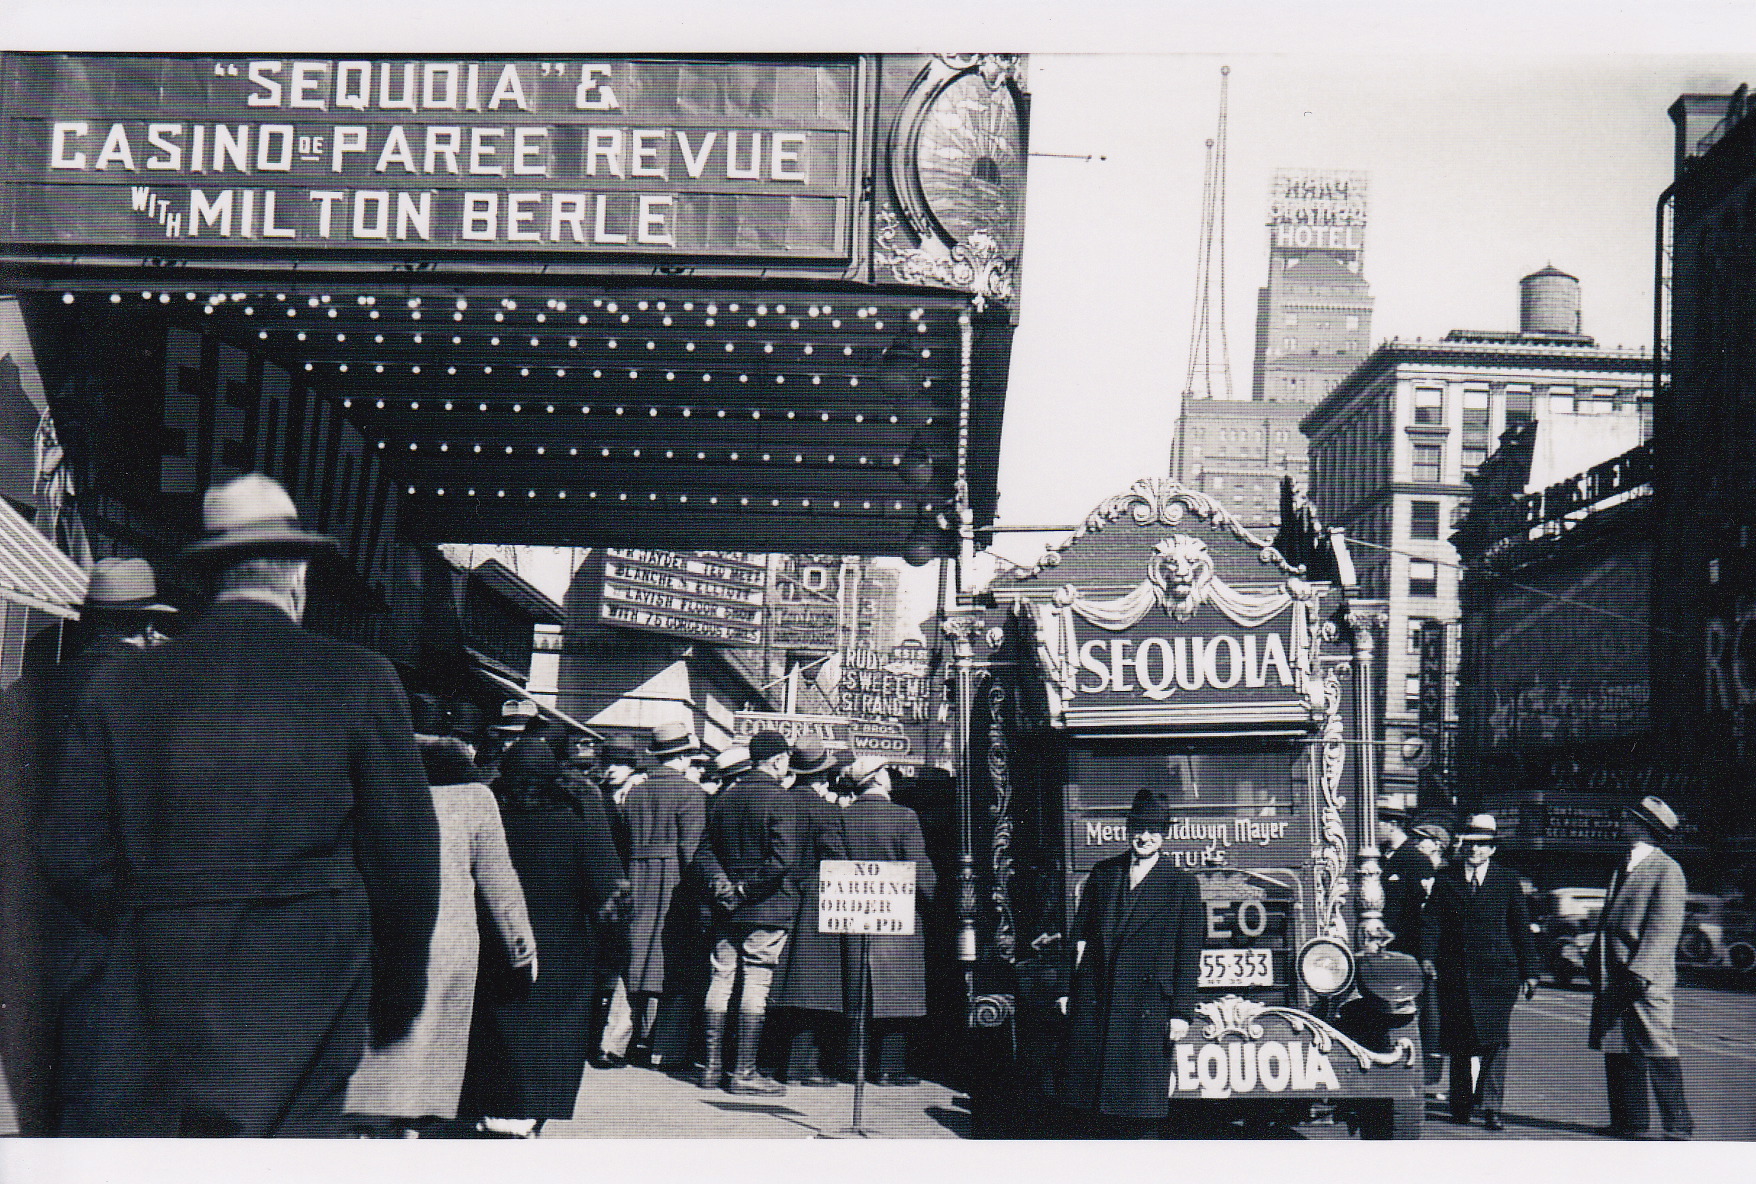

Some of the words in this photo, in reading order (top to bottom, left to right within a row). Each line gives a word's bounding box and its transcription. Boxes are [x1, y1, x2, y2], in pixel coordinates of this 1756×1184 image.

[576, 64, 620, 110] &
[51, 121, 293, 173] CASINO
[299, 136, 324, 161] DE
[332, 125, 550, 178] PAREE
[585, 132, 808, 182] REVUE
[131, 186, 182, 239] WITH
[188, 190, 433, 241] MILTON
[462, 196, 677, 247] BERLE
[1277, 227, 1360, 250] HOTEL
[624, 586, 673, 607] LAVISH
[607, 602, 638, 621] WITH
[1080, 634, 1292, 702] SEQUOIA
[855, 737, 906, 750] WOOD
[1234, 818, 1289, 846] Mayer
[854, 863, 880, 876] NO
[819, 880, 914, 895] PARKING
[821, 899, 891, 915] ORDER
[1206, 900, 1267, 938] EO
[1168, 1041, 1340, 1098] EQUOIA
